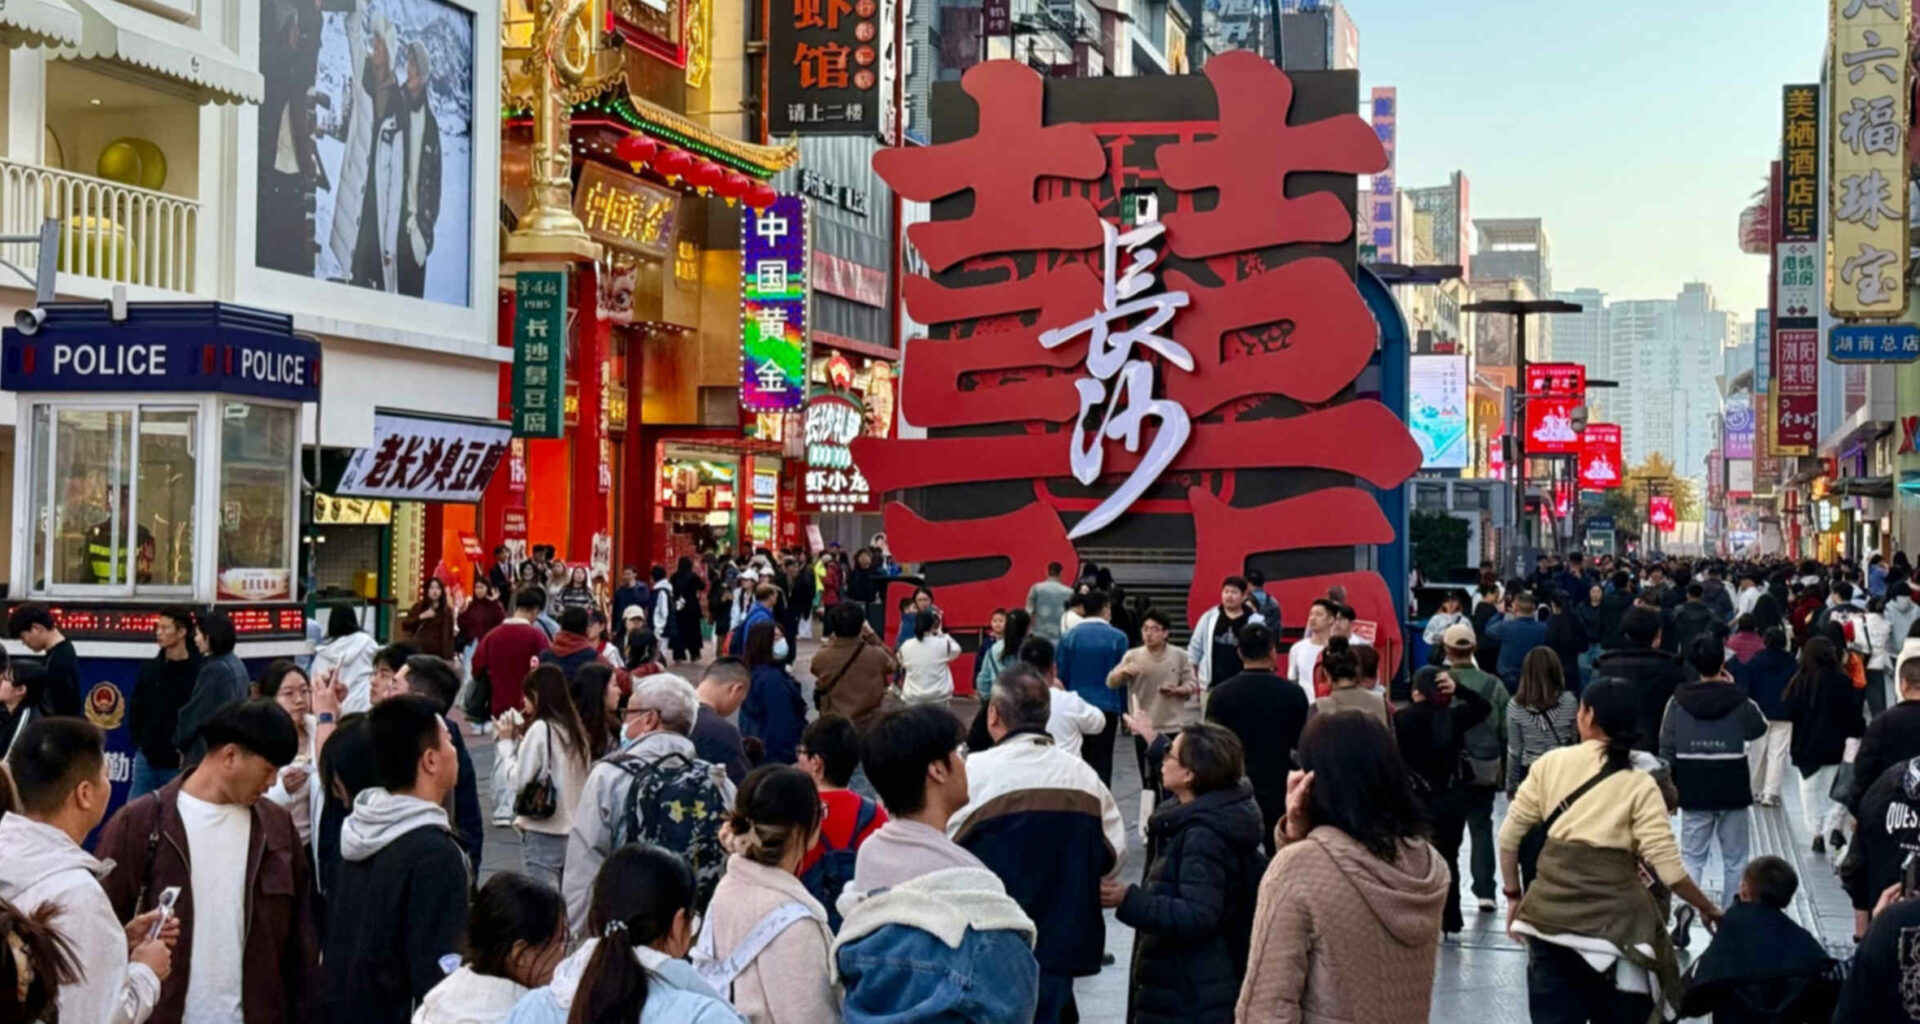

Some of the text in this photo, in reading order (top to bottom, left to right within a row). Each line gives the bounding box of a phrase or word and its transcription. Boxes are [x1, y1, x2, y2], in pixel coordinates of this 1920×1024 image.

[789, 103, 863, 122] 请上二楼
[1787, 90, 1816, 205] 美栖酒店
[1835, 334, 1919, 352] 湖南总店
[53, 345, 167, 375] POLICE
[241, 349, 305, 385] POLICE
[104, 751, 131, 782] 勤
[1886, 802, 1920, 834] QUES
